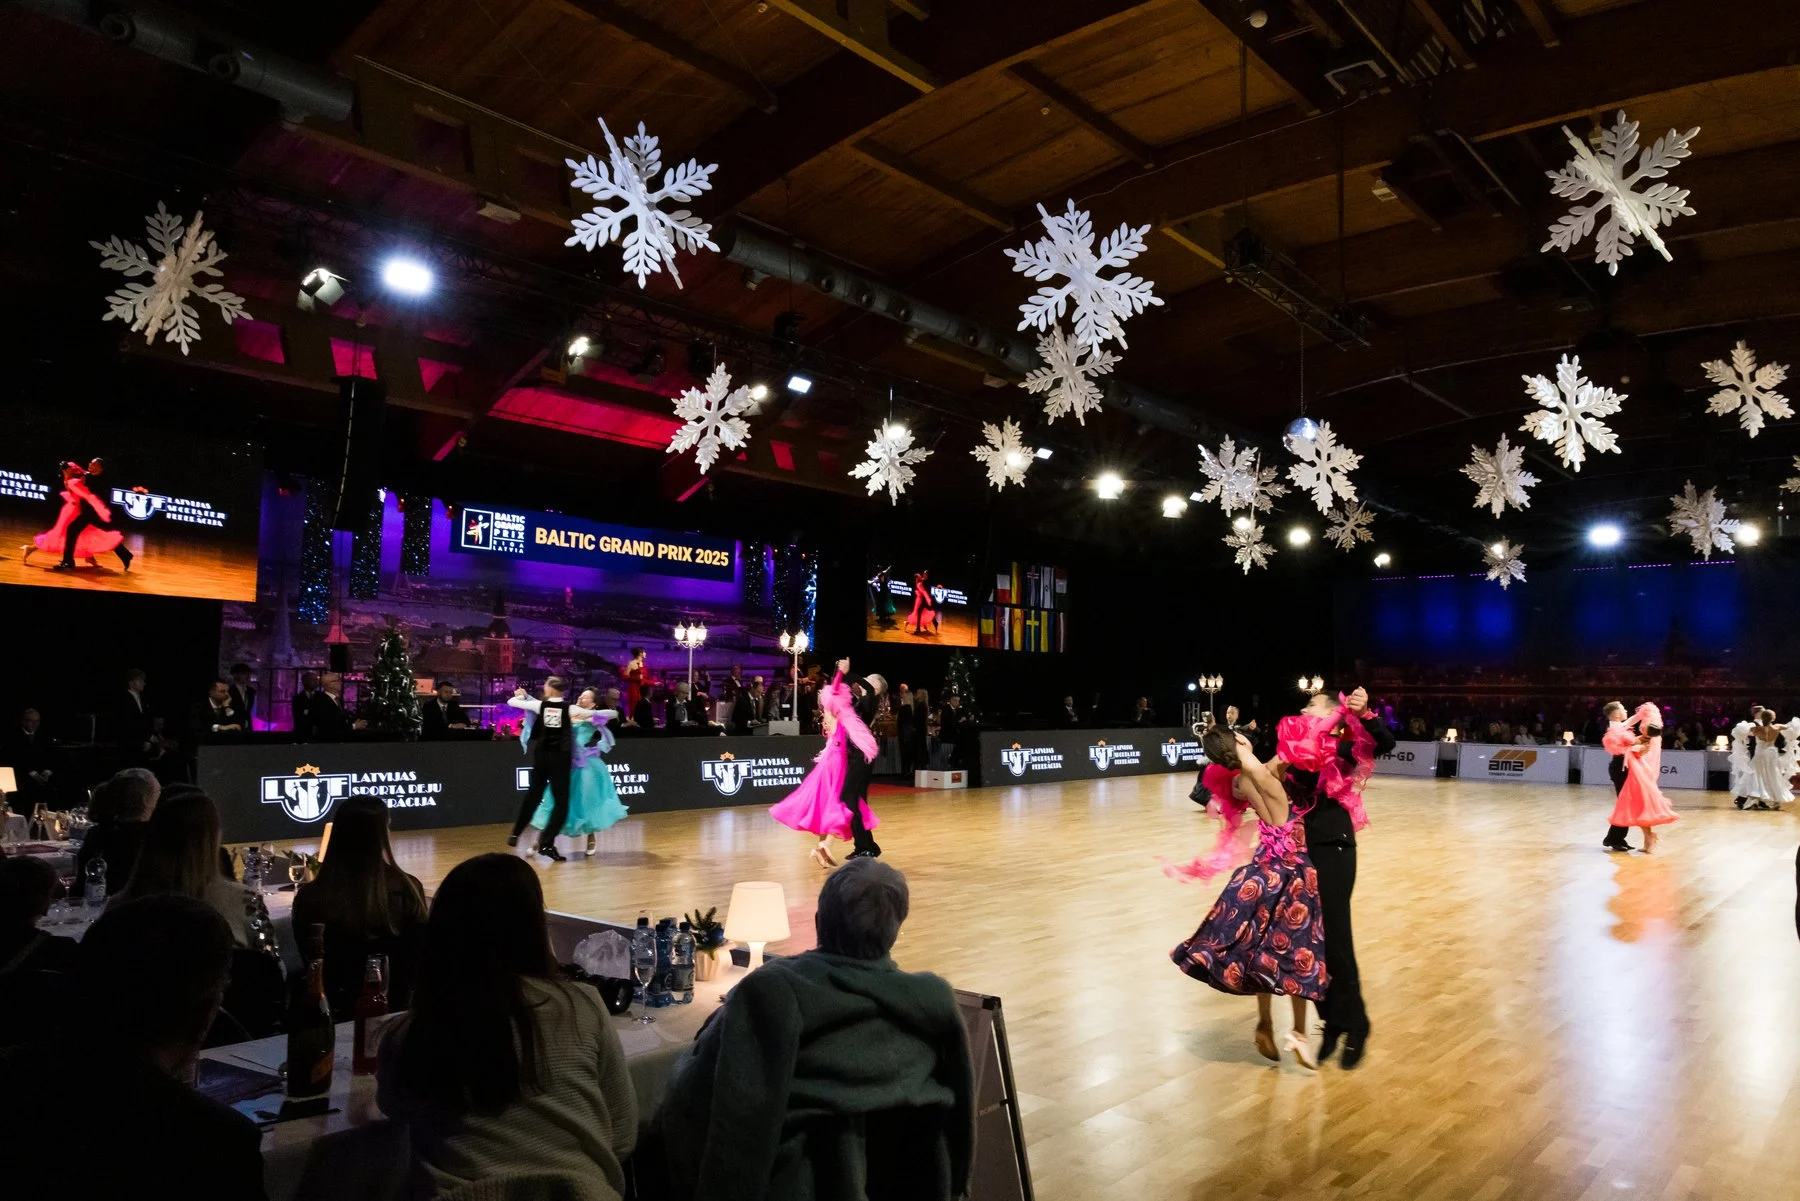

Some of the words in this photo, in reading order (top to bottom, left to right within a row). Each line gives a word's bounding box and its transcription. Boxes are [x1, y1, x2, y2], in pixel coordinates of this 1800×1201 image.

[494, 512, 526, 524] BALTIC
[494, 520, 525, 532] GRAND
[493, 528, 525, 540] PRIX
[492, 539, 525, 549] RIGA
[492, 545, 524, 554] LATVIA
[535, 527, 596, 551] BALTIC
[599, 535, 655, 558] GRAND
[657, 543, 693, 563] PRIX
[695, 549, 729, 567] 2025
[751, 757, 790, 767] LATVIJAS
[352, 770, 417, 783] LATVIJAS
[623, 773, 650, 784] DEJU
[408, 783, 442, 794] DEJU
[615, 784, 646, 795] ĀCIJA
[385, 795, 437, 808] RĀCIJA
